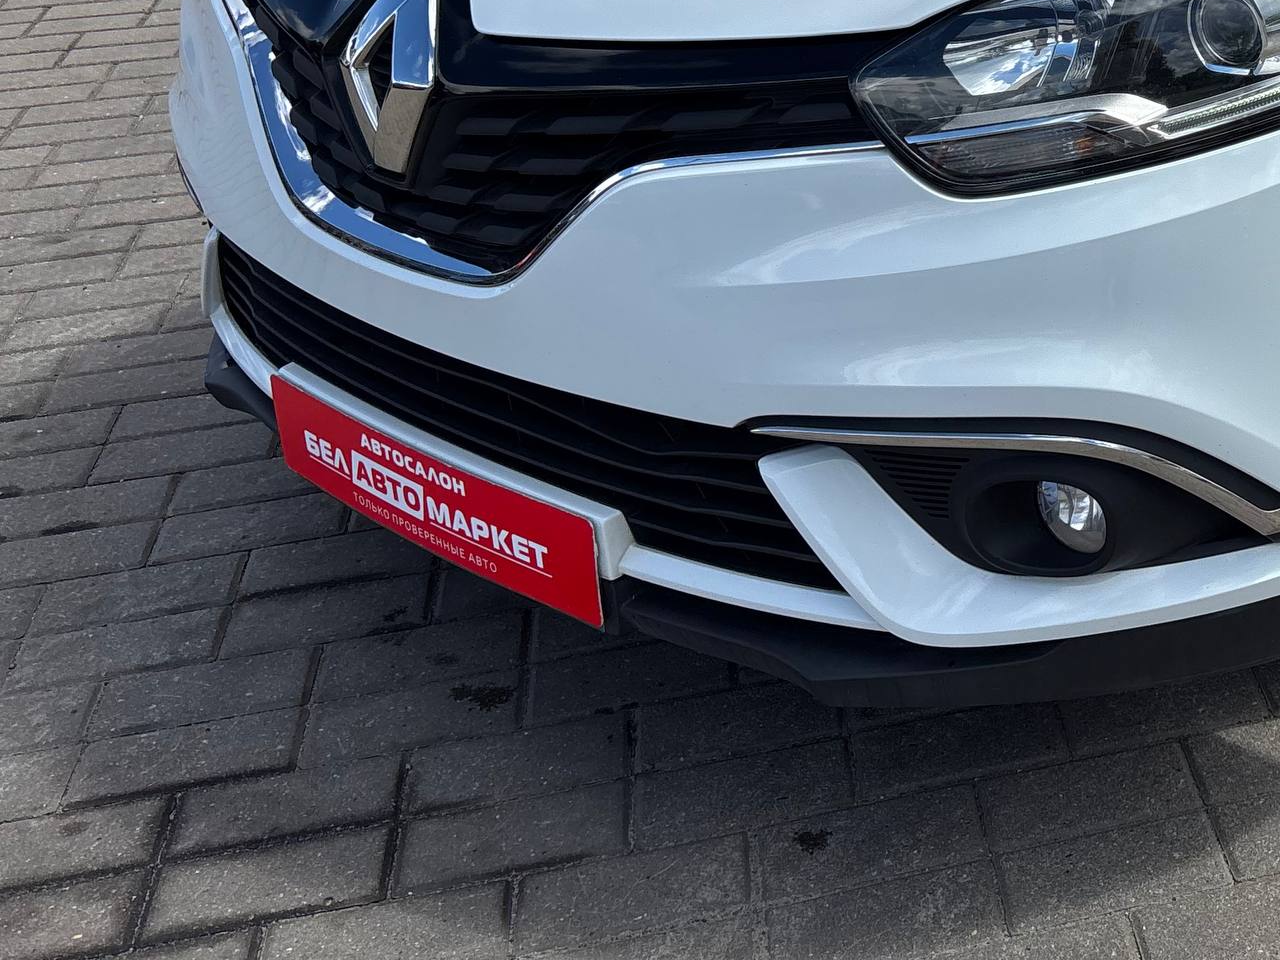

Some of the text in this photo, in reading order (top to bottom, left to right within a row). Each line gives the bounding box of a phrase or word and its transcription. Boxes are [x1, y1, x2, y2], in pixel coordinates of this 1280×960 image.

[360, 433, 466, 496] АВТОСАЛОН
[353, 491, 498, 574] ТОЛЬКО ПРОВЕРЕННЫЕ АВТО
